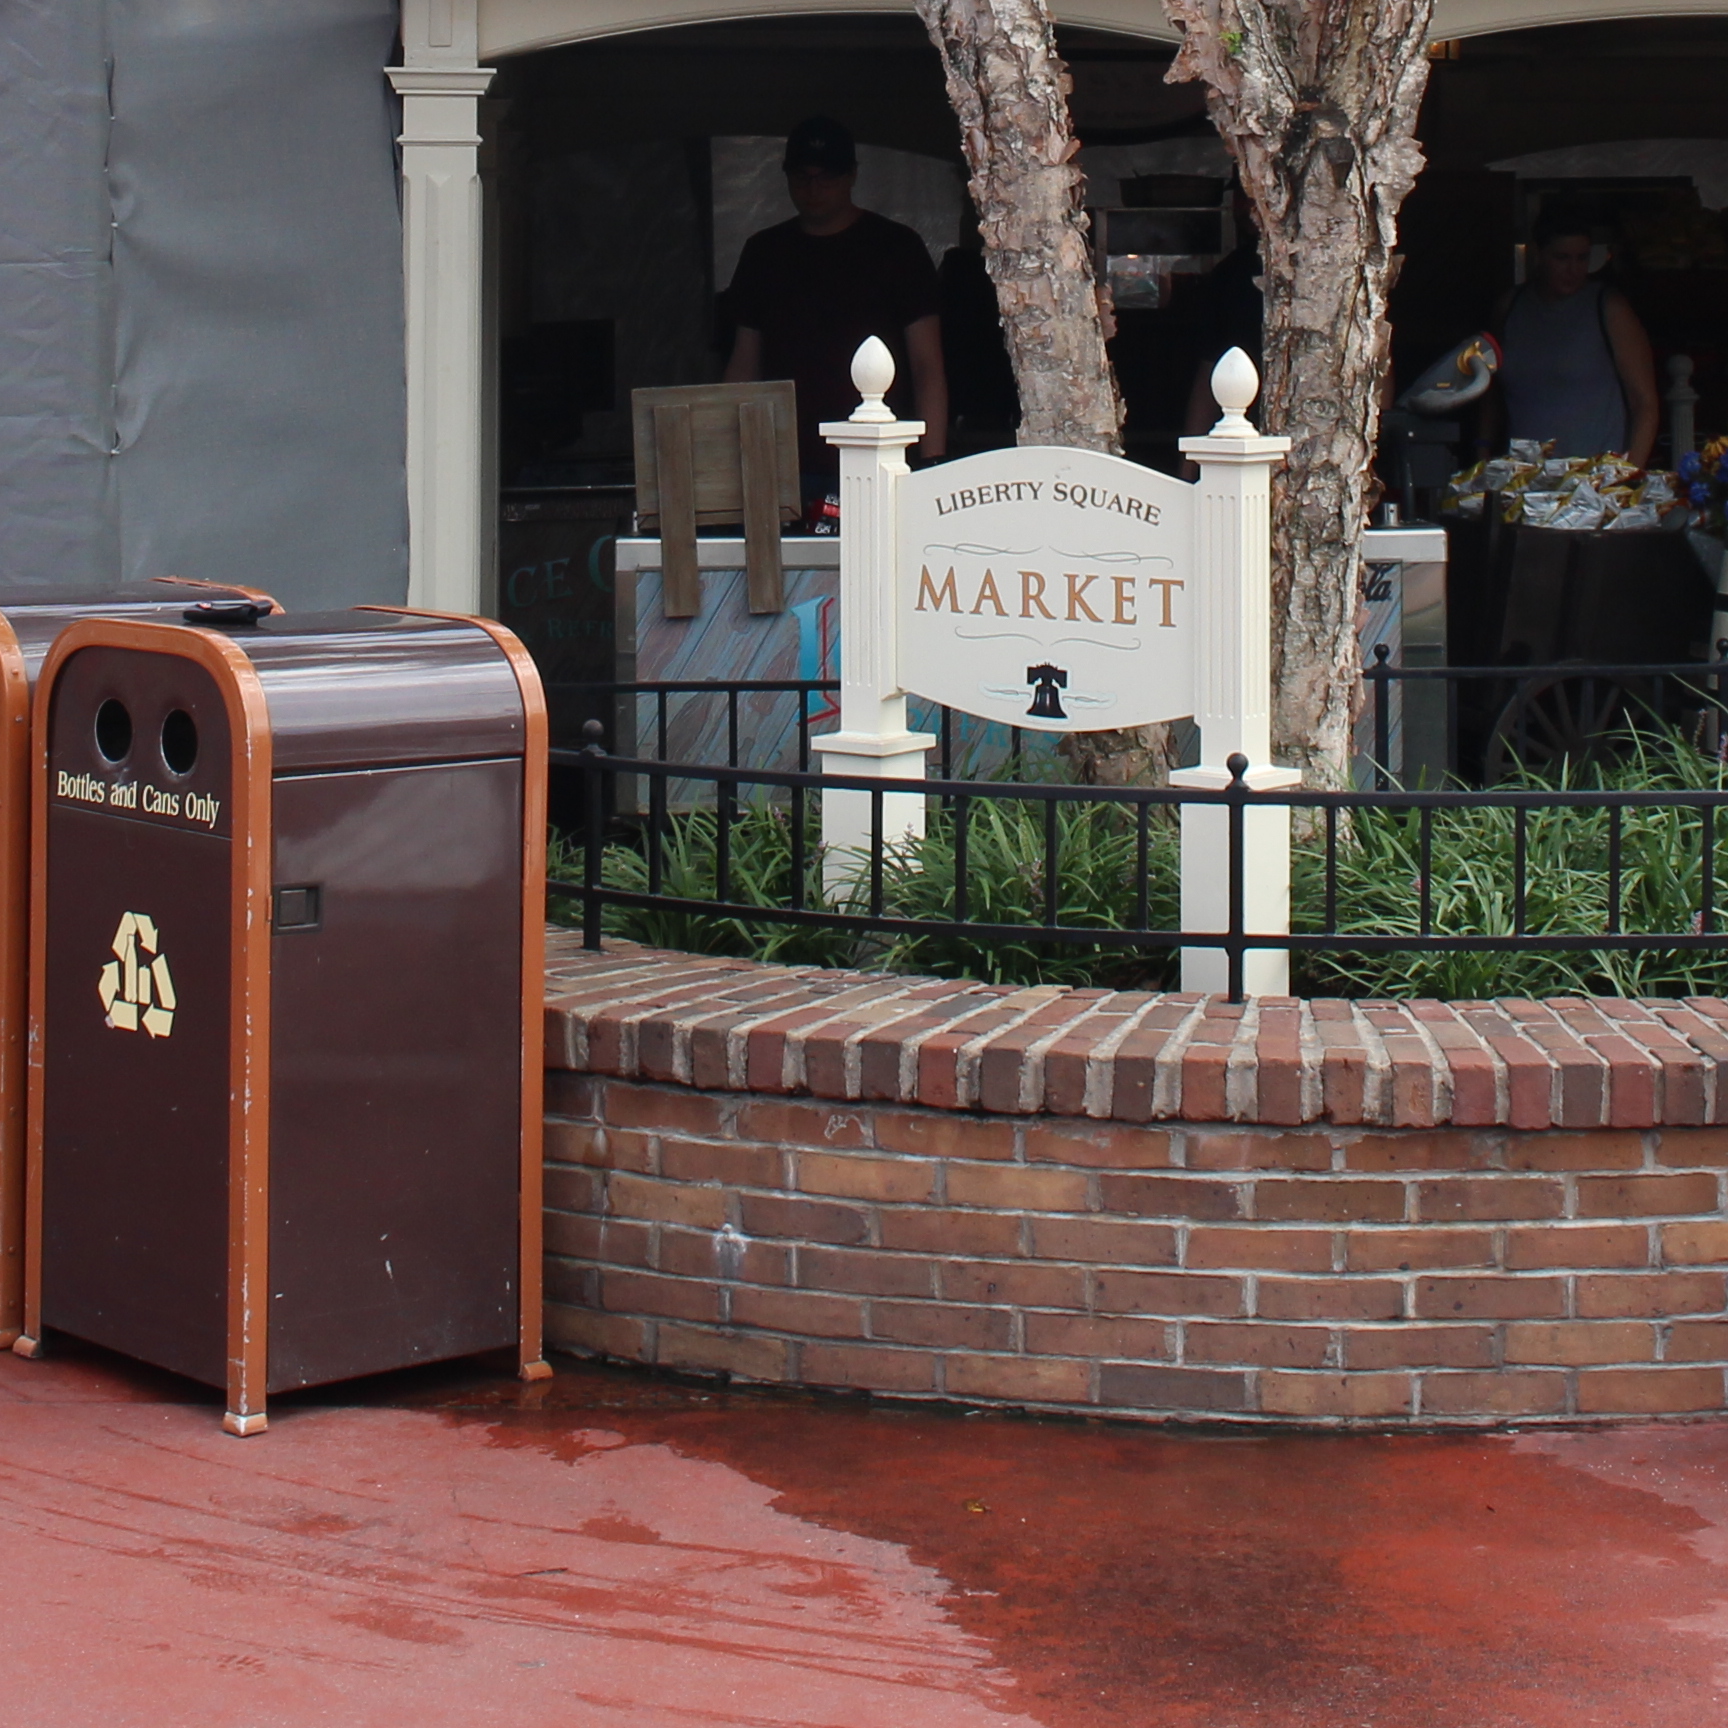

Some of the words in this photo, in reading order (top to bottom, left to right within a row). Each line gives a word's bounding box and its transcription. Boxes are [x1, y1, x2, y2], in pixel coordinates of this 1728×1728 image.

[934, 480, 1044, 516] LIBERTY
[1053, 481, 1161, 526] SQUARE
[914, 563, 1185, 628] MARKET
[57, 770, 106, 804] Bottles
[110, 780, 138, 809] and
[142, 784, 179, 816] Cans
[185, 791, 221, 830] Only
